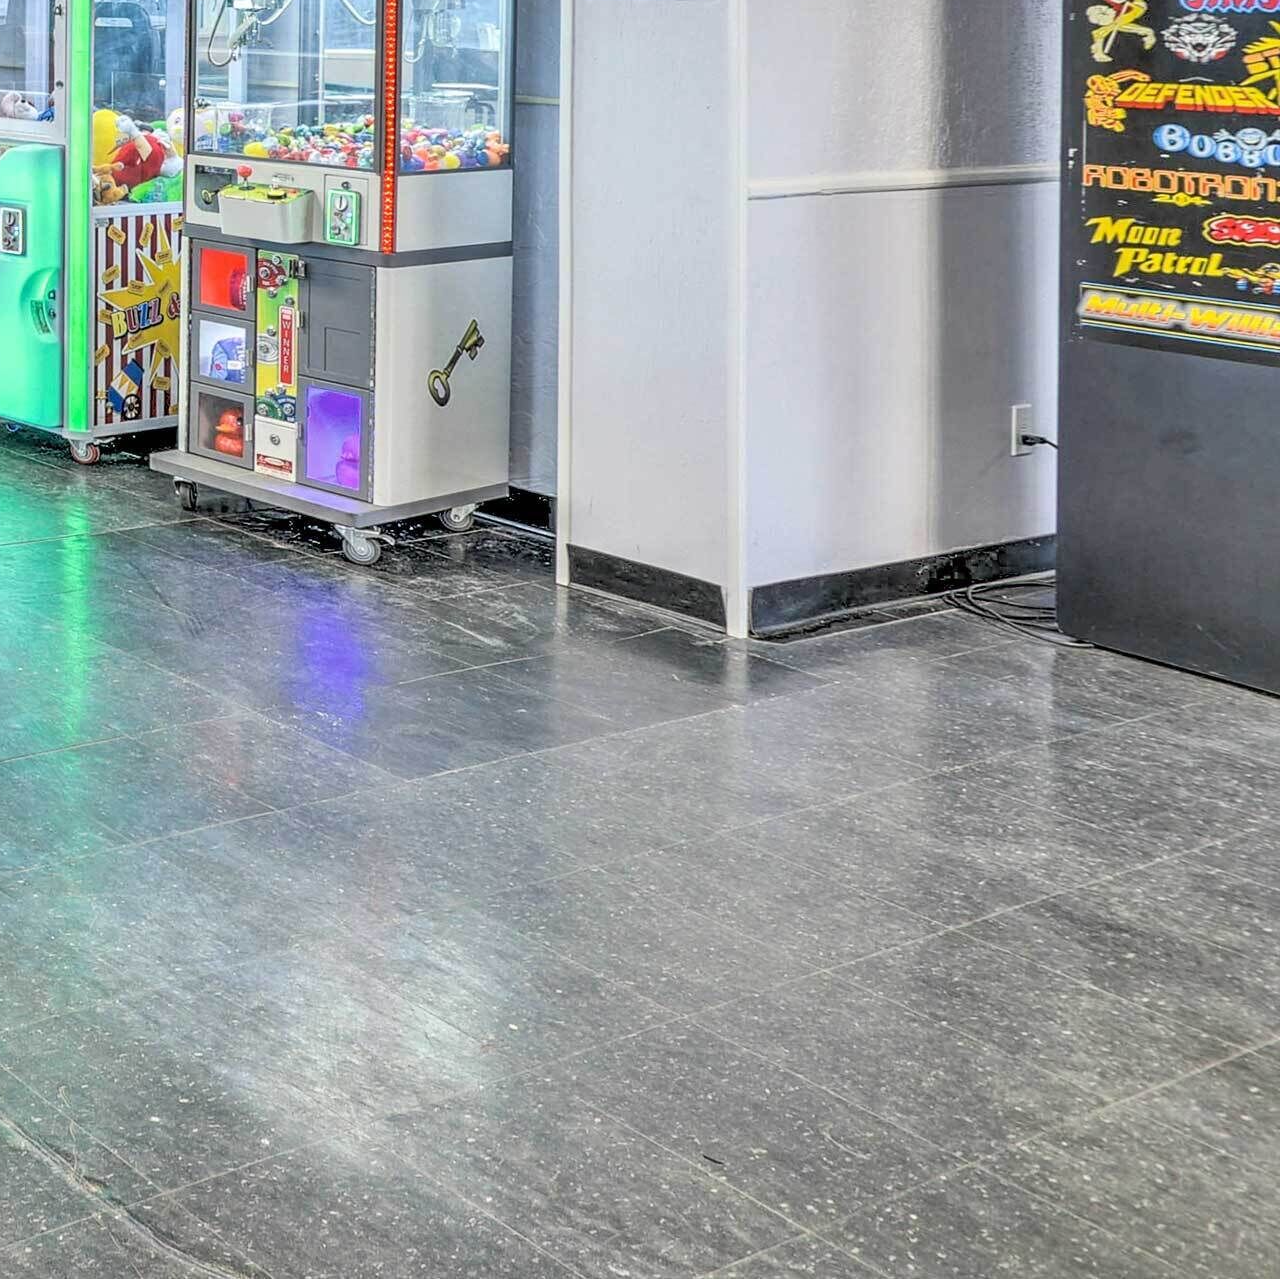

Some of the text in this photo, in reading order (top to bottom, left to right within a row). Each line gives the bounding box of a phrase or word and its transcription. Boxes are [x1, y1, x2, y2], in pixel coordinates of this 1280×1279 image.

[1114, 81, 1280, 116] DEFENDER
[1085, 217, 1183, 246] Moon
[111, 297, 163, 339] BUZZ
[281, 321, 292, 374] WINNER
